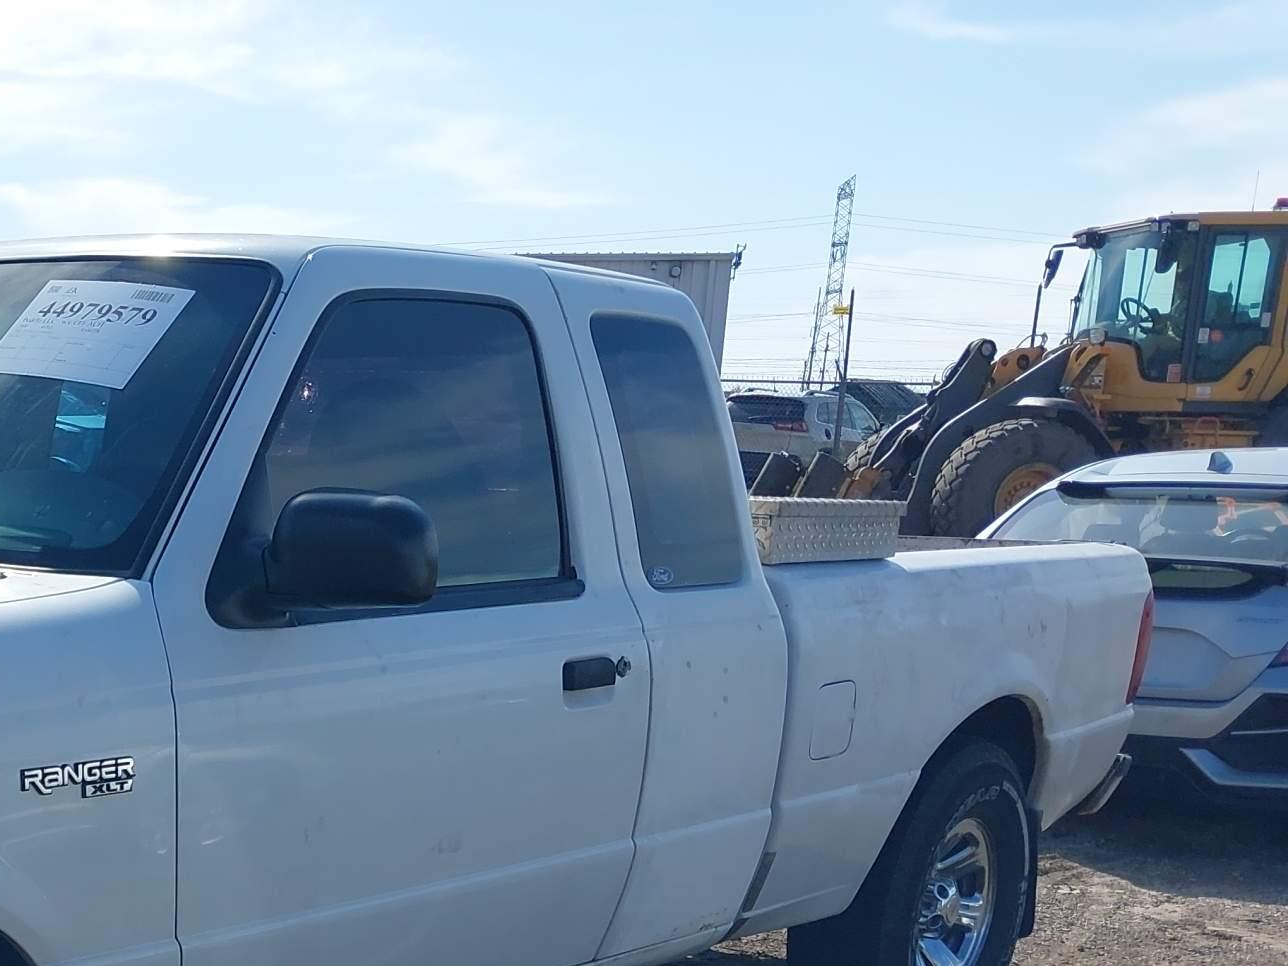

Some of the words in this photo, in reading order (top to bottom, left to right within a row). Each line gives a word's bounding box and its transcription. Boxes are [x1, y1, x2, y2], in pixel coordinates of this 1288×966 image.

[38, 301, 158, 326] 44979579
[20, 756, 135, 795] RANGER
[90, 781, 128, 795] XLT
